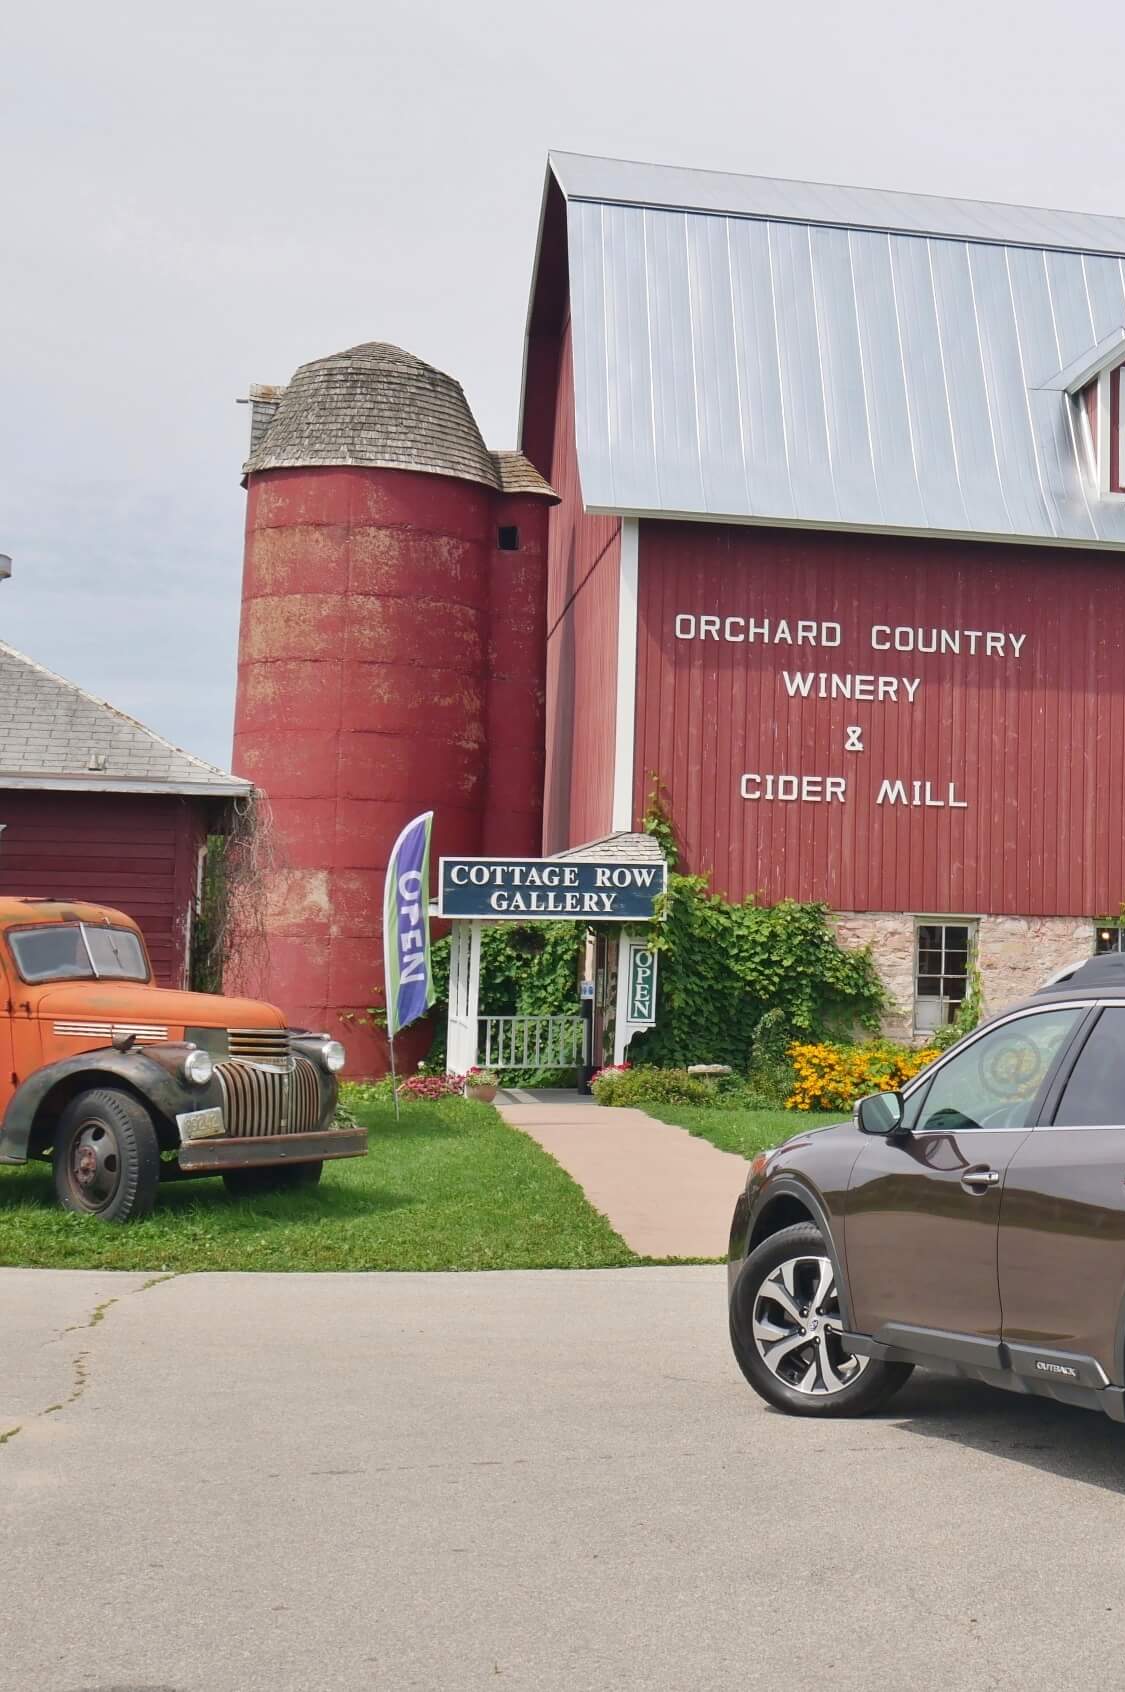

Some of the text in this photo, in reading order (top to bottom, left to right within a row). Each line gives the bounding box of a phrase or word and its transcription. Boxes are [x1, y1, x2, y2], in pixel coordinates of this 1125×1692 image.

[675, 614, 1026, 658] ORCHARD COUNTRY
[783, 671, 920, 702] WINERY
[844, 725, 864, 752] &
[740, 774, 968, 808] CIDER MILL
[450, 865, 656, 888] COTTAGE ROW
[490, 891, 617, 912] GALLERY
[398, 869, 425, 985] OPEN
[633, 950, 653, 1018] OPEN
[1036, 1361, 1076, 1377] OUTBACK
